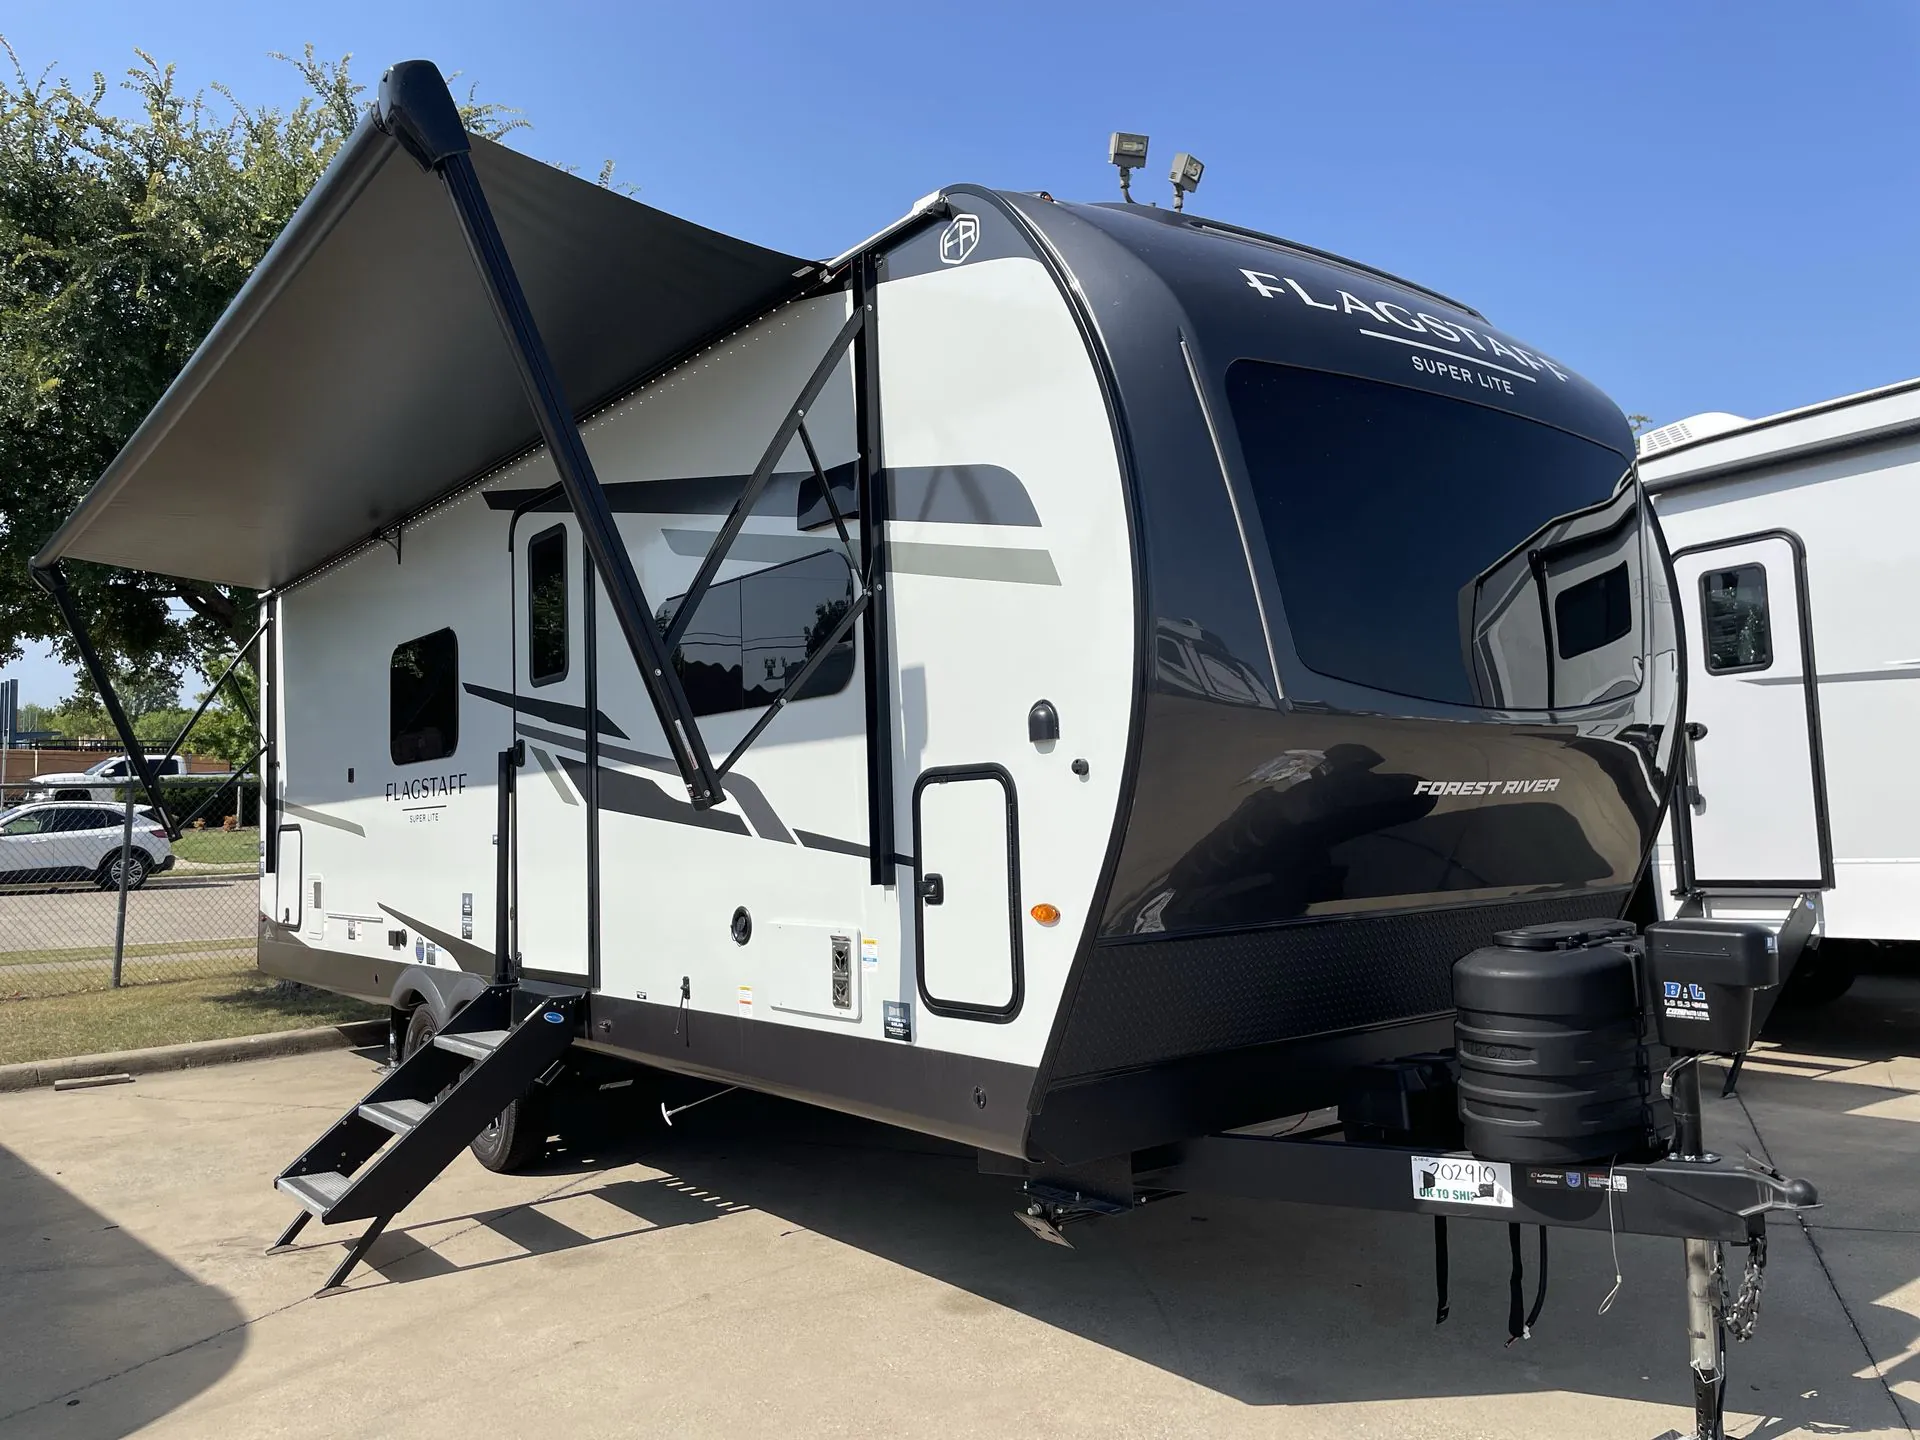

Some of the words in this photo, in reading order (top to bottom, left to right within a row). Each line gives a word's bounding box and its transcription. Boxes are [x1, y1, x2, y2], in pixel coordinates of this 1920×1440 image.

[1238, 268, 1570, 383] FLAGSTAFF
[1412, 355, 1474, 385] SUPER
[1479, 374, 1515, 395] LITE
[385, 773, 468, 802] FLAGSTAFF
[1413, 780, 1503, 796] FOREST
[1501, 778, 1561, 795] RIVER
[409, 813, 427, 824] SUPER
[427, 812, 439, 822] LITE
[1429, 1161, 1497, 1183] 202910
[1436, 1188, 1449, 1199] TO
